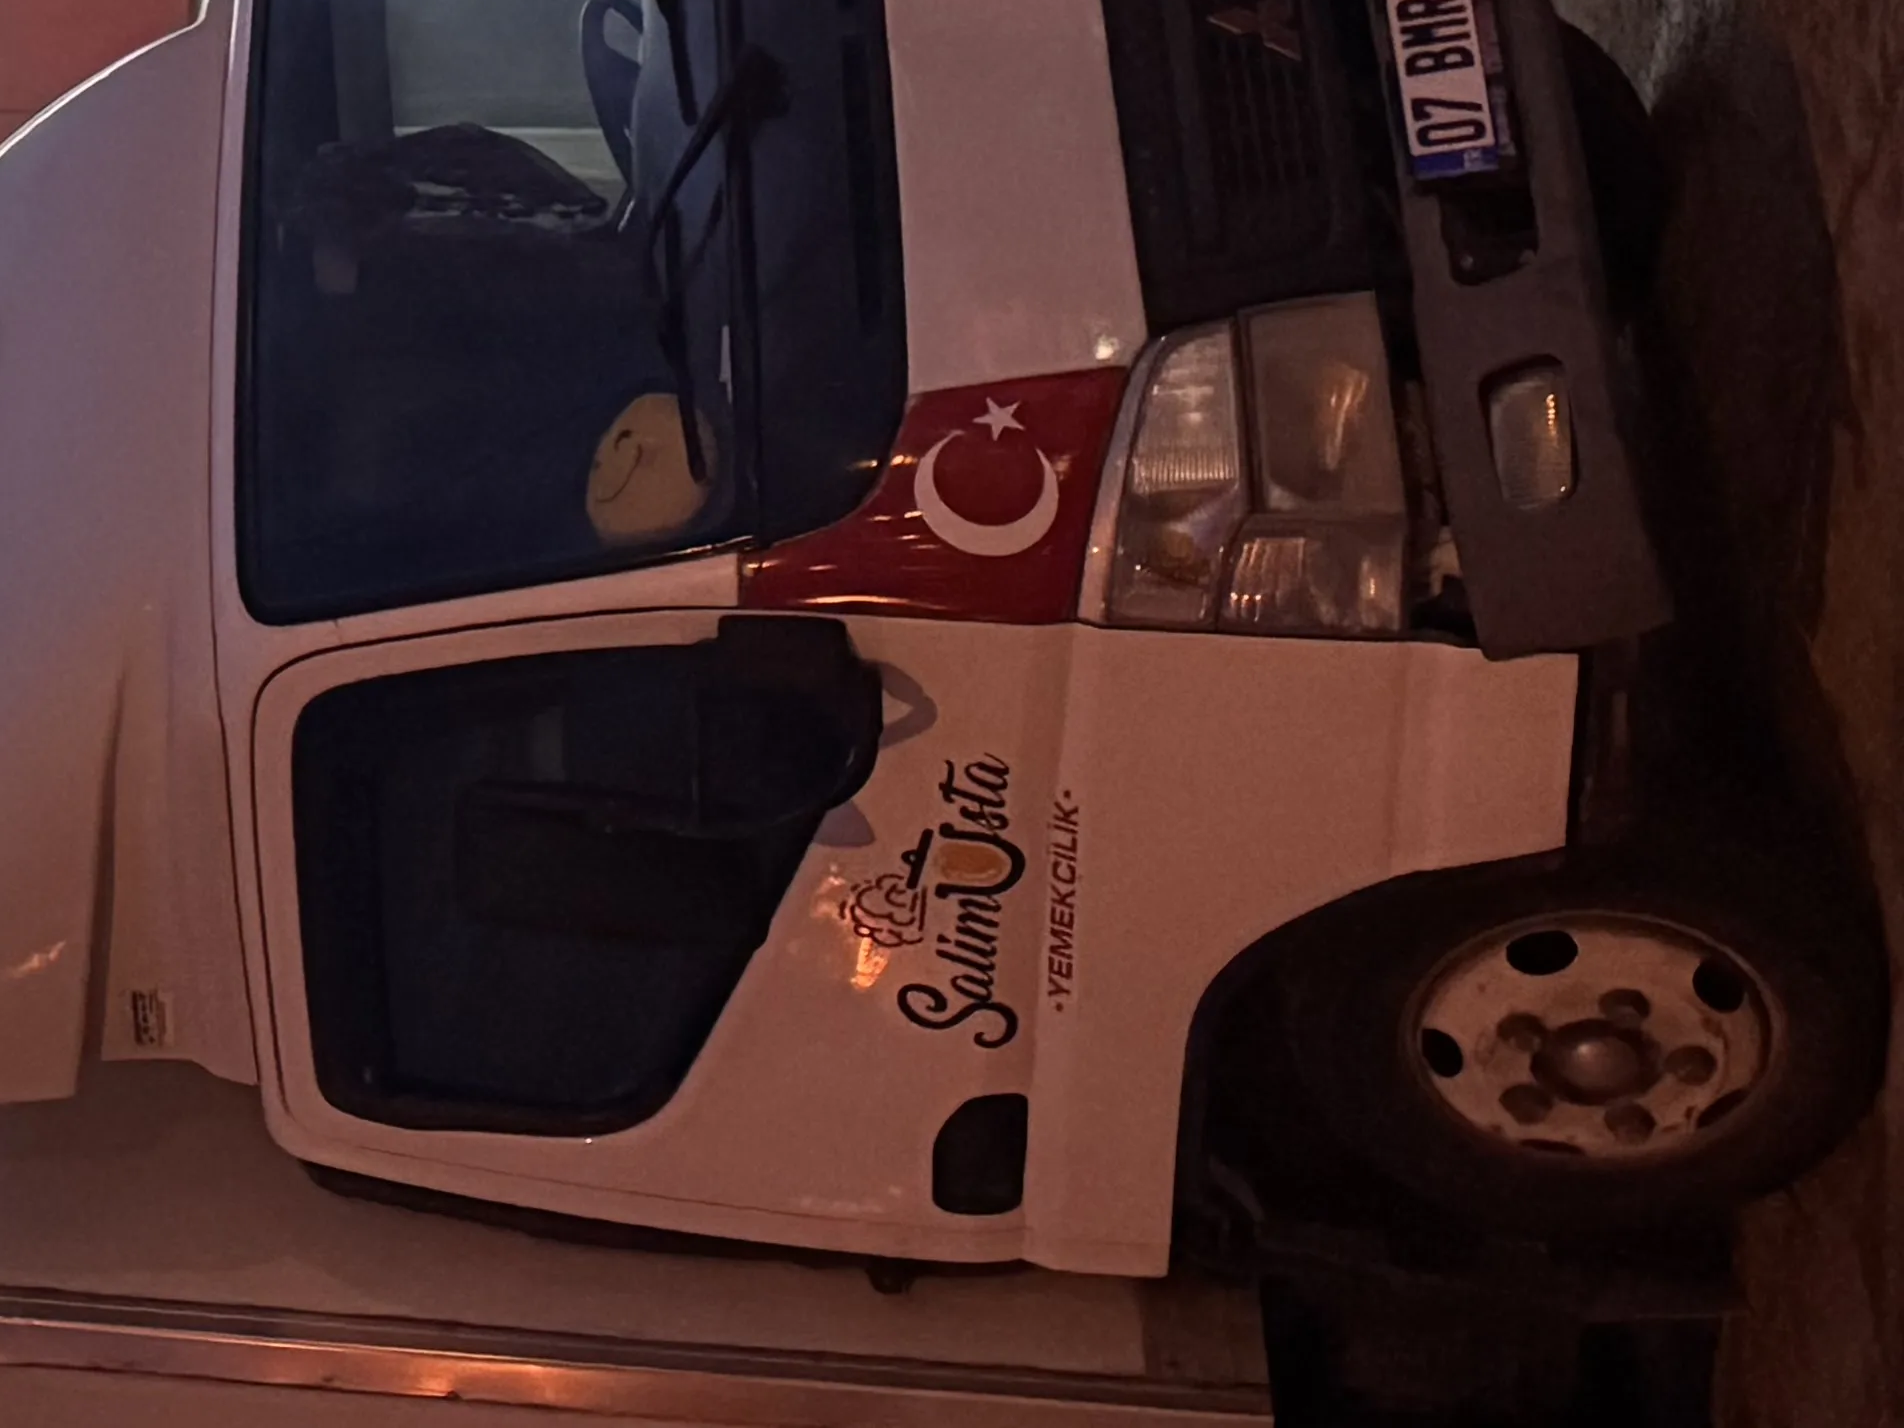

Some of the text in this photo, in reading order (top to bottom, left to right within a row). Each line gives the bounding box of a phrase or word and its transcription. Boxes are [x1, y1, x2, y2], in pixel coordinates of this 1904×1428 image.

[1410, 98, 1487, 148] 07
[897, 752, 1026, 1049] Salim Usta
